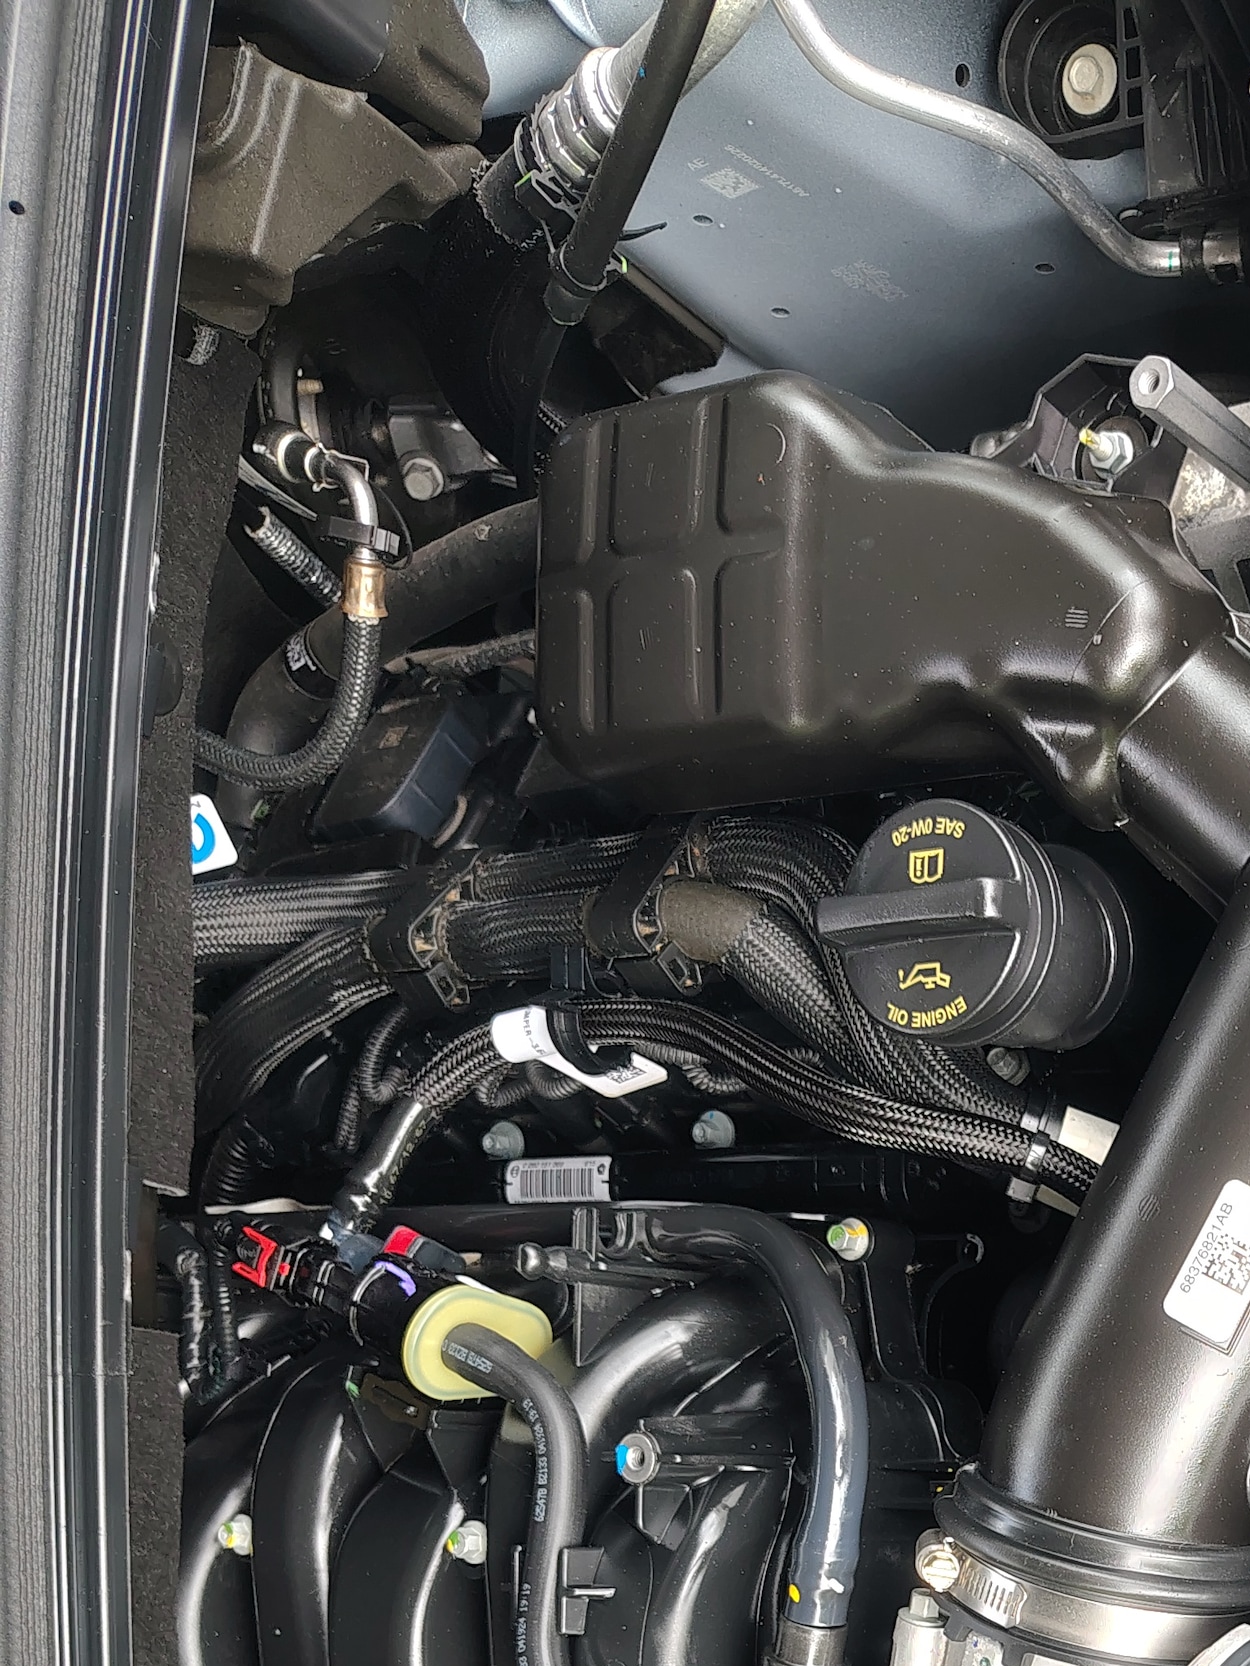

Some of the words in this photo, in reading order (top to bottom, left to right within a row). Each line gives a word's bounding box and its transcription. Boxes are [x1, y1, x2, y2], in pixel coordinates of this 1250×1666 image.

[891, 817, 934, 847] 0W-20
[934, 816, 966, 839] SAE
[887, 1002, 909, 1025] OIL
[911, 995, 968, 1028] ENGINE
[1180, 1203, 1233, 1293] 68376821AB
